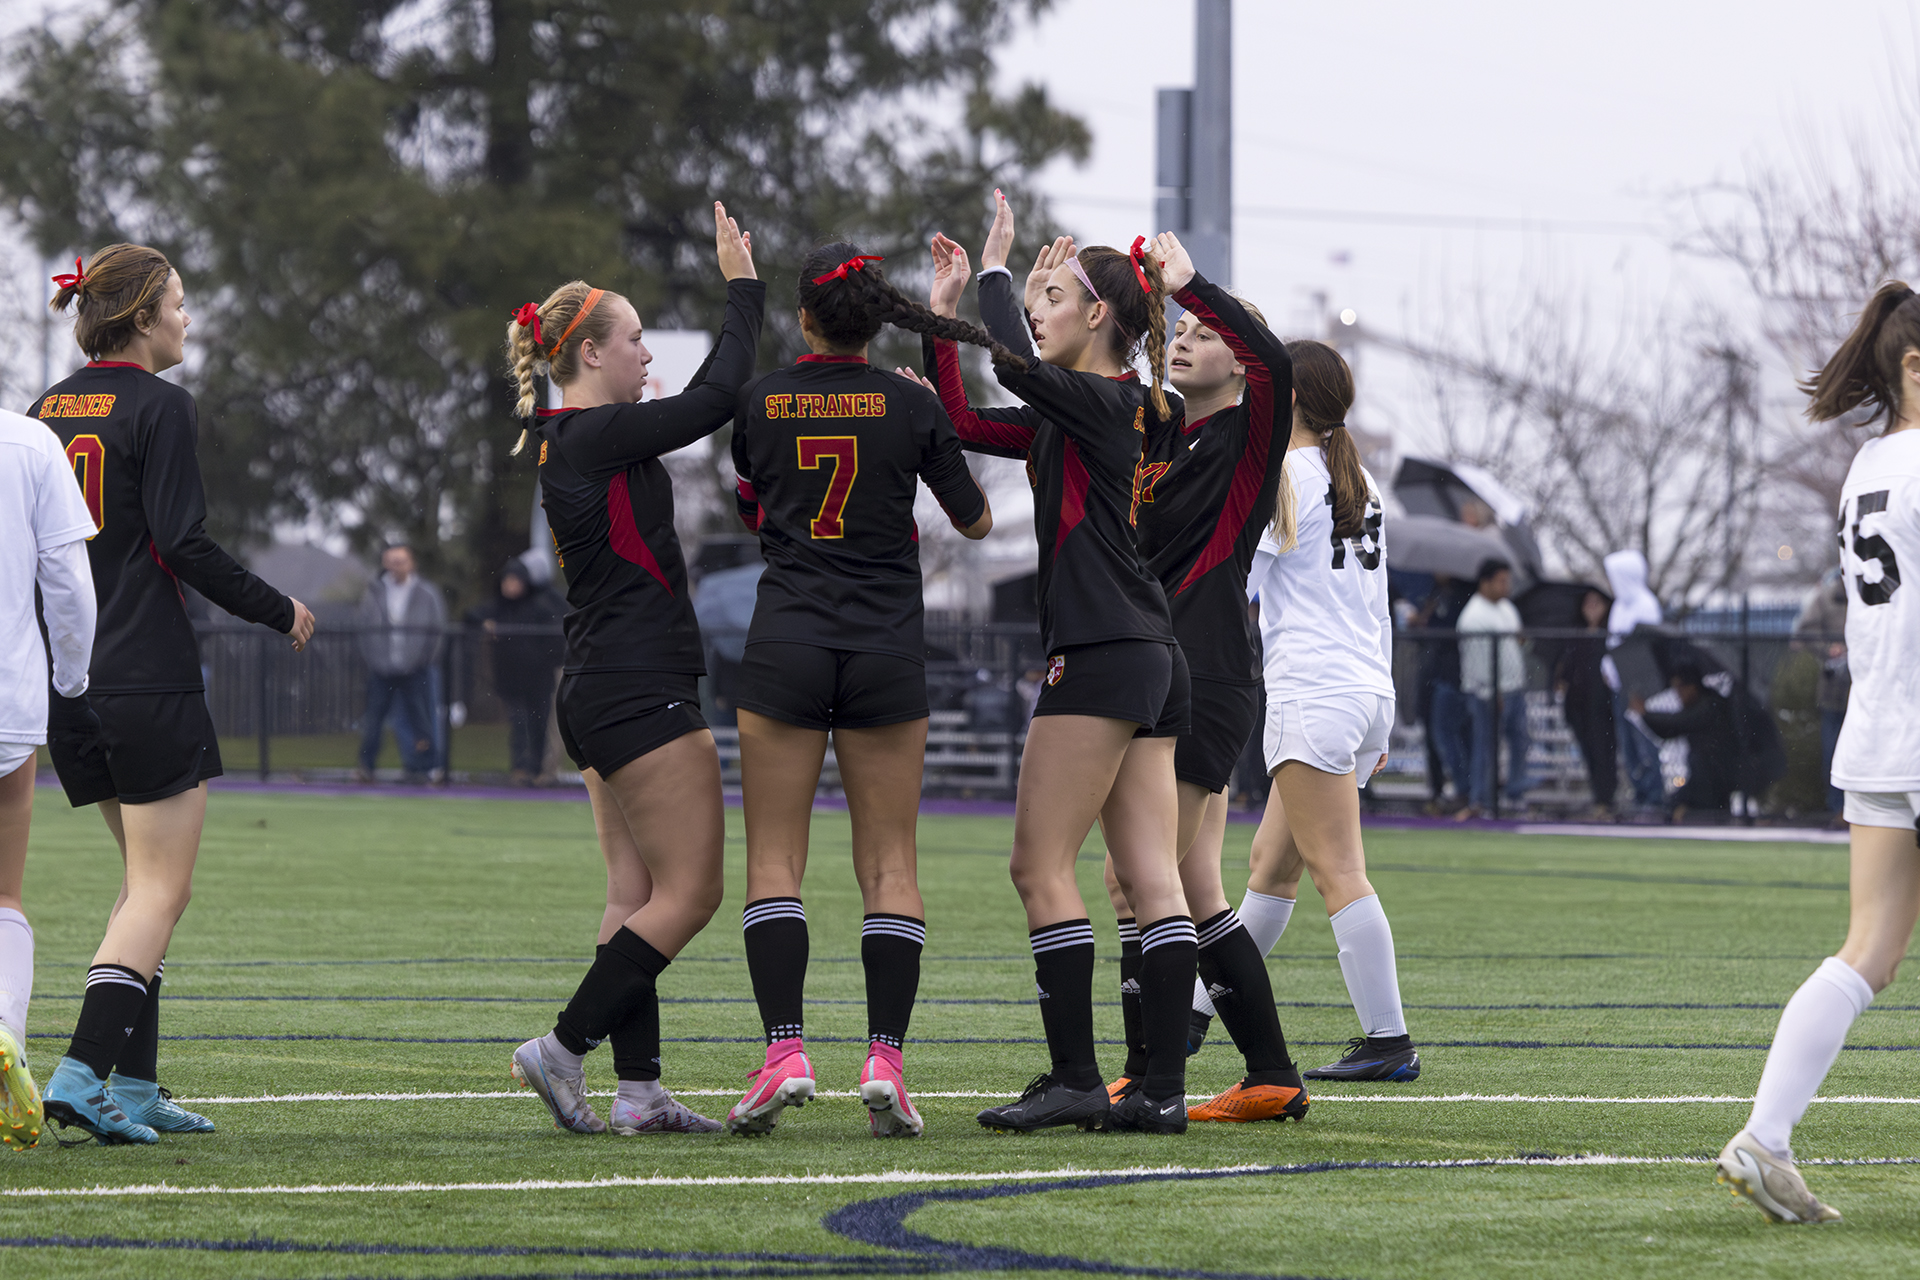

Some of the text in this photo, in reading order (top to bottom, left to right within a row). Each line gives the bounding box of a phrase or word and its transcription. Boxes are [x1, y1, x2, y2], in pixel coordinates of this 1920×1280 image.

[38, 394, 117, 419] ST.FRANCIS
[765, 393, 886, 419] ST.FRANCIS
[796, 435, 859, 539] 7
